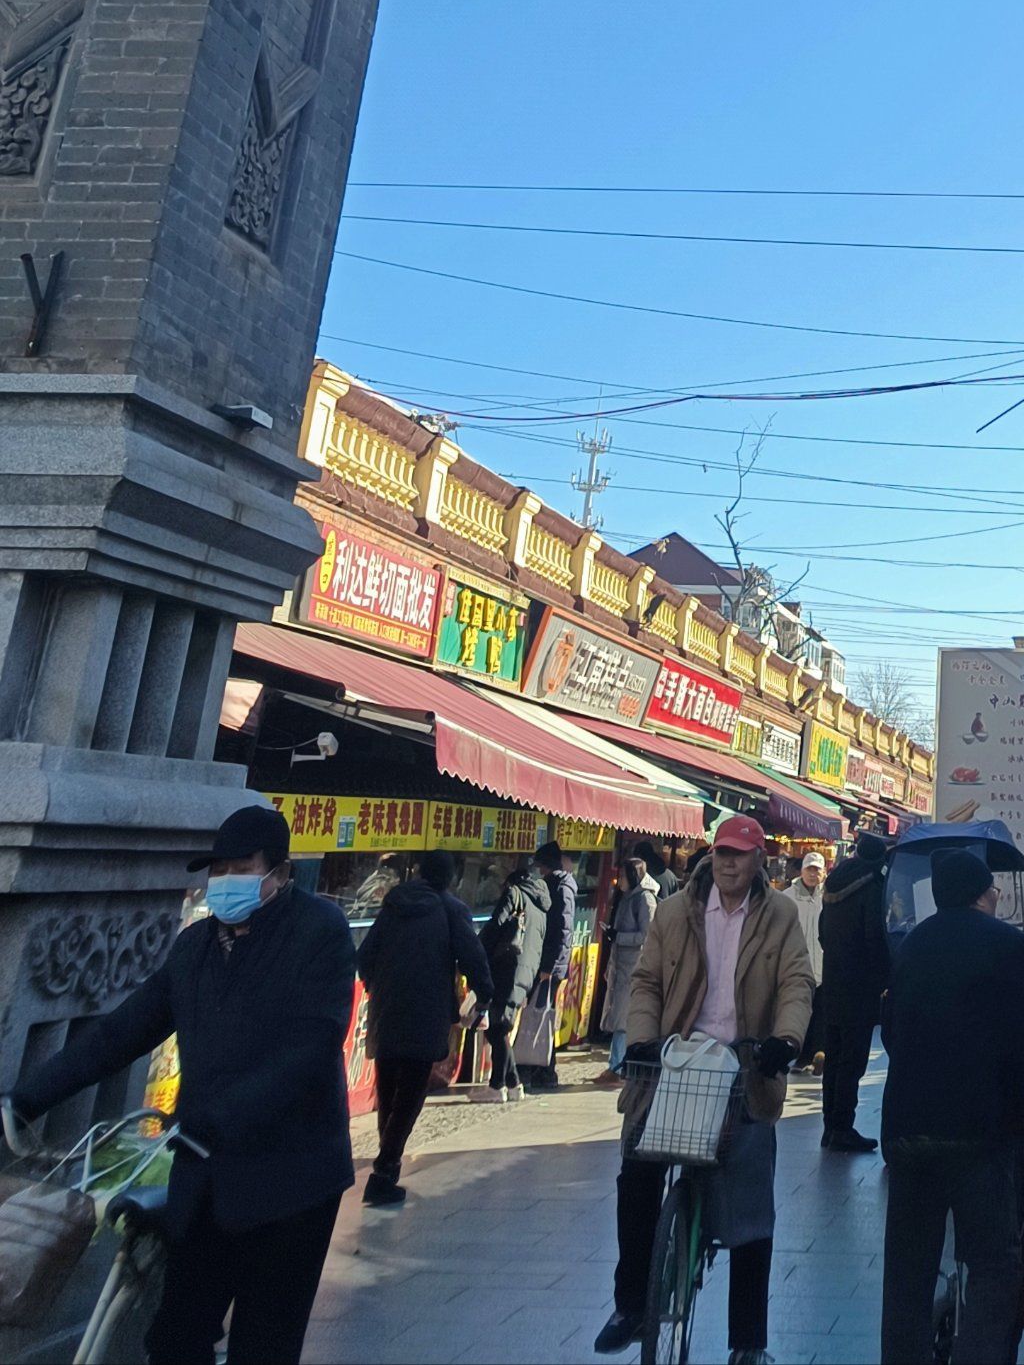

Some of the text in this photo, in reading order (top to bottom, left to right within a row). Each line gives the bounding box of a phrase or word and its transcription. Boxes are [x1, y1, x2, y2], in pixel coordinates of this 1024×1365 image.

[332, 538, 436, 631] 利达鲜切面批发
[291, 796, 337, 836] 油炸货
